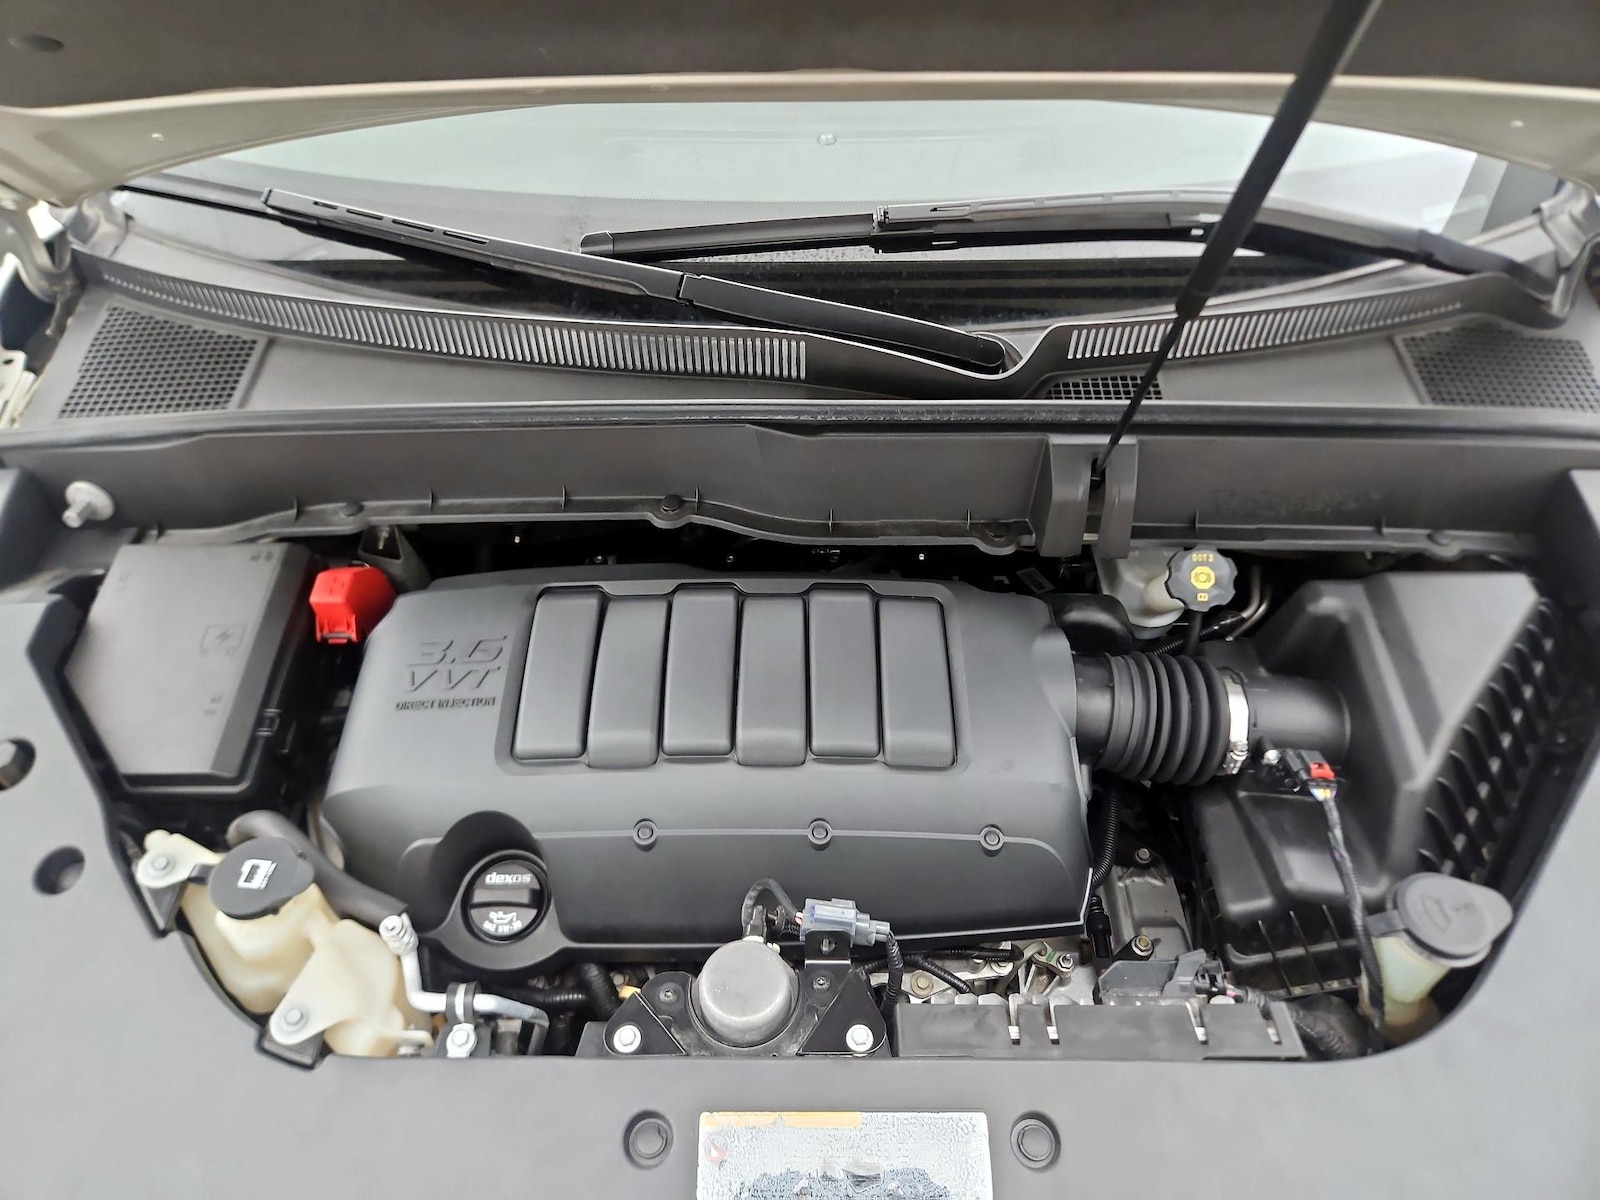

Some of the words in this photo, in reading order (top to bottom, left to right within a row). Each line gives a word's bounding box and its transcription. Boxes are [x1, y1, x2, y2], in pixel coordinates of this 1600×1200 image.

[404, 666, 502, 693] VVT
[395, 700, 436, 711] DIRECT
[437, 696, 496, 709] INJECTION
[484, 871, 533, 886] dexos
